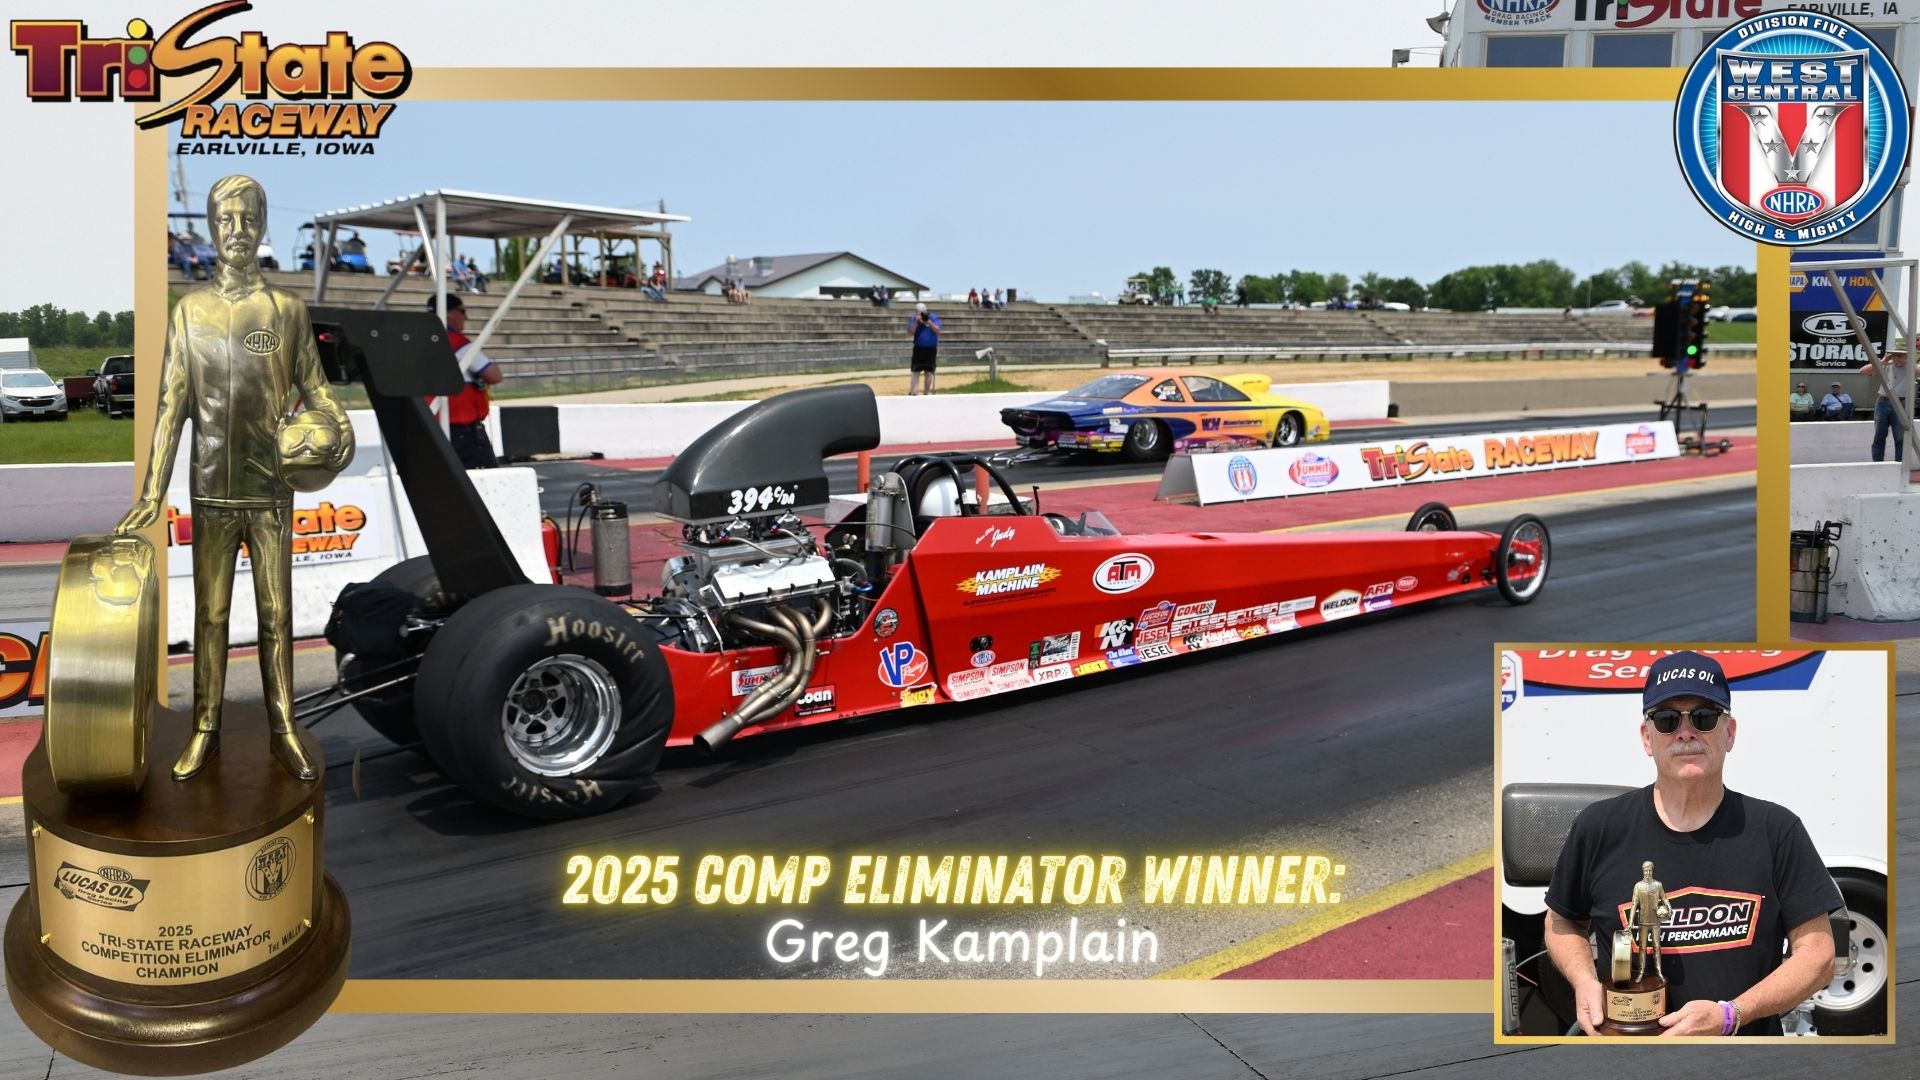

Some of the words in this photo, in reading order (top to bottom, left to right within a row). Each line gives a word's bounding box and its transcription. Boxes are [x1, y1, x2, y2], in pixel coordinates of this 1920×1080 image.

[1491, 11, 1512, 20] DRAG
[1515, 10, 1544, 20] RACING
[1883, 2, 1898, 16] IA
[1484, 15, 1519, 26] MEMBER
[1523, 14, 1552, 25] TRACK
[244, 333, 280, 352] NHRA
[1483, 431, 1600, 470] RACEWAY
[727, 487, 774, 515] 394
[320, 551, 352, 560] IOWA
[975, 563, 1046, 583] KAMPLAIN
[1107, 560, 1142, 582] ATM
[975, 577, 1040, 597] MACHINE
[1366, 583, 1393, 597] ARP
[1177, 603, 1207, 617] COMP
[1323, 596, 1359, 611] WELDON
[1136, 627, 1169, 644] JESEL
[1202, 627, 1239, 643] Hayden
[1140, 644, 1173, 659] JESEL
[880, 642, 914, 686] VP
[991, 661, 1026, 677] SIMPSON
[951, 670, 986, 686] SIMPSON
[1038, 669, 1062, 681] XRP
[1656, 668, 1695, 685] LUCAS
[1698, 668, 1716, 685] OIL
[956, 686, 991, 699] SIMPSON
[996, 679, 1030, 691] SIMPSON
[62, 871, 109, 894] LUCAS
[109, 885, 135, 899] OIL
[98, 932, 174, 951] TRI-STATE
[178, 924, 254, 951] RACEWAY
[158, 925, 194, 937] 2025
[1667, 924, 1749, 942] PERFORMANCE
[81, 941, 180, 964] COMPETITION
[185, 930, 272, 964] ELIMINATOR
[136, 962, 220, 979] CHAMPION
